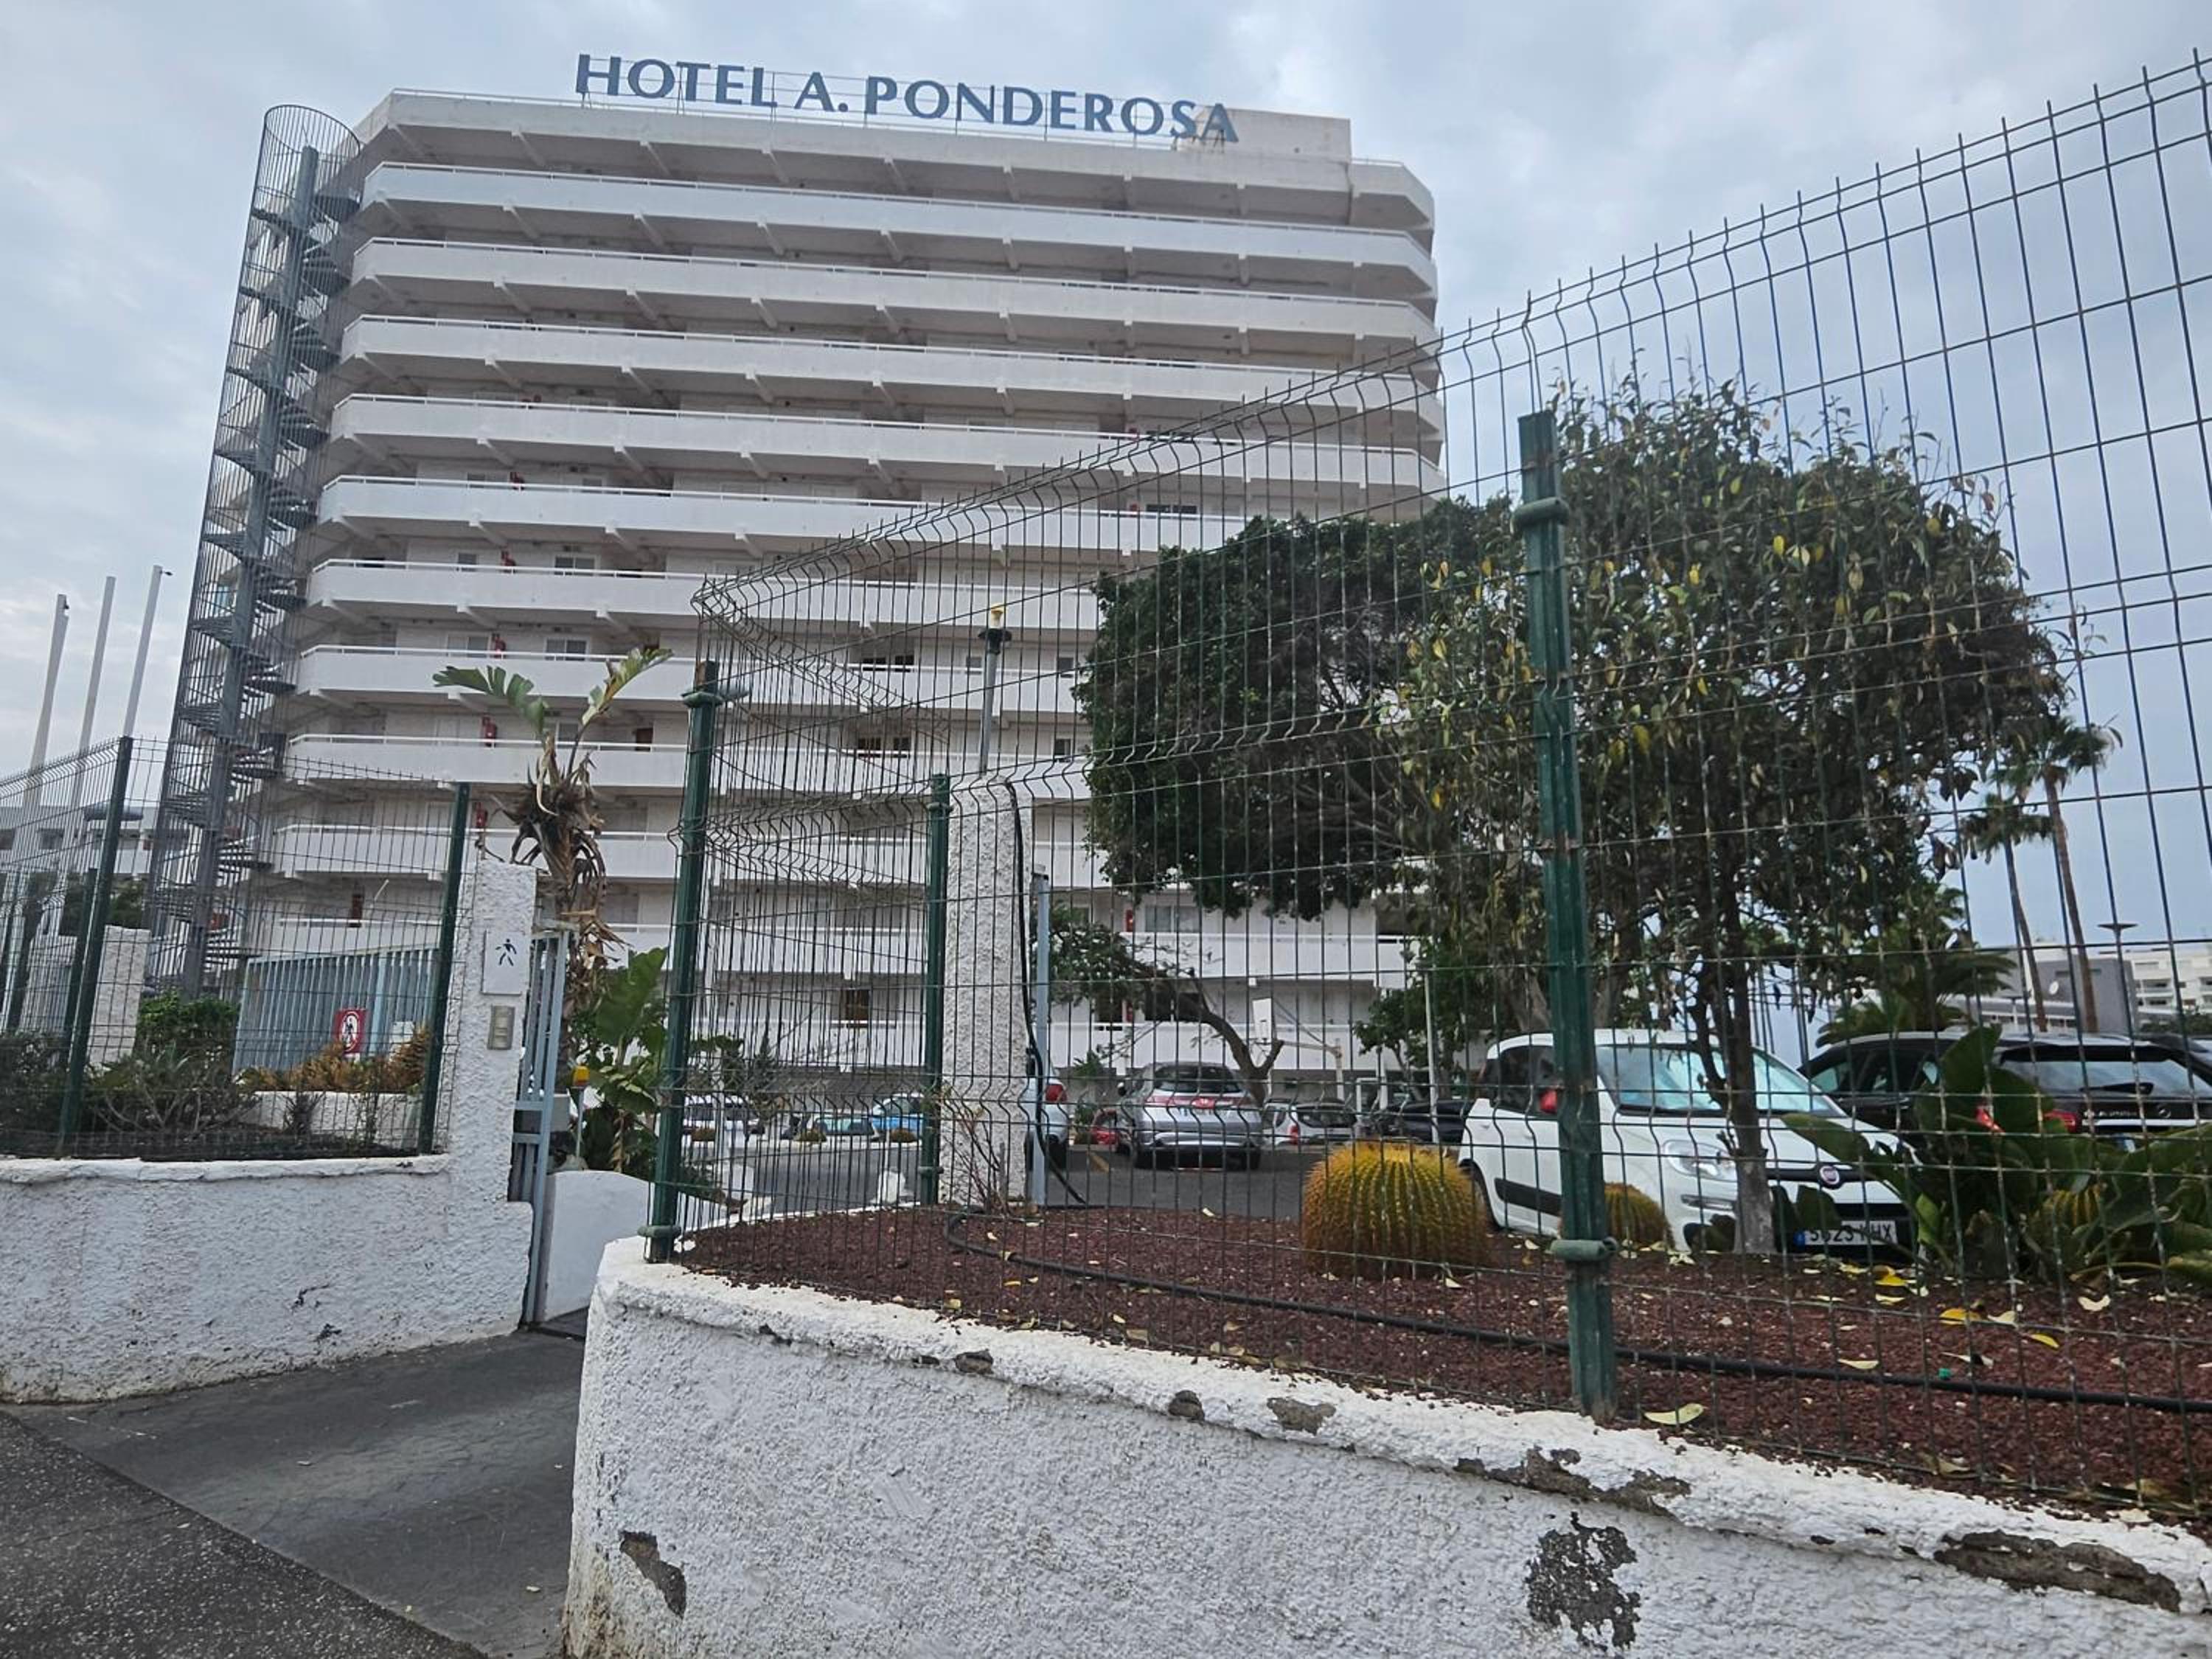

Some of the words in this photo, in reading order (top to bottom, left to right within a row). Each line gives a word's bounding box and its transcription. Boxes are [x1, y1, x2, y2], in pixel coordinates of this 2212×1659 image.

[576, 54, 778, 108] HOTEL
[794, 72, 849, 113] A.
[863, 75, 1239, 143] PONDEROSA
